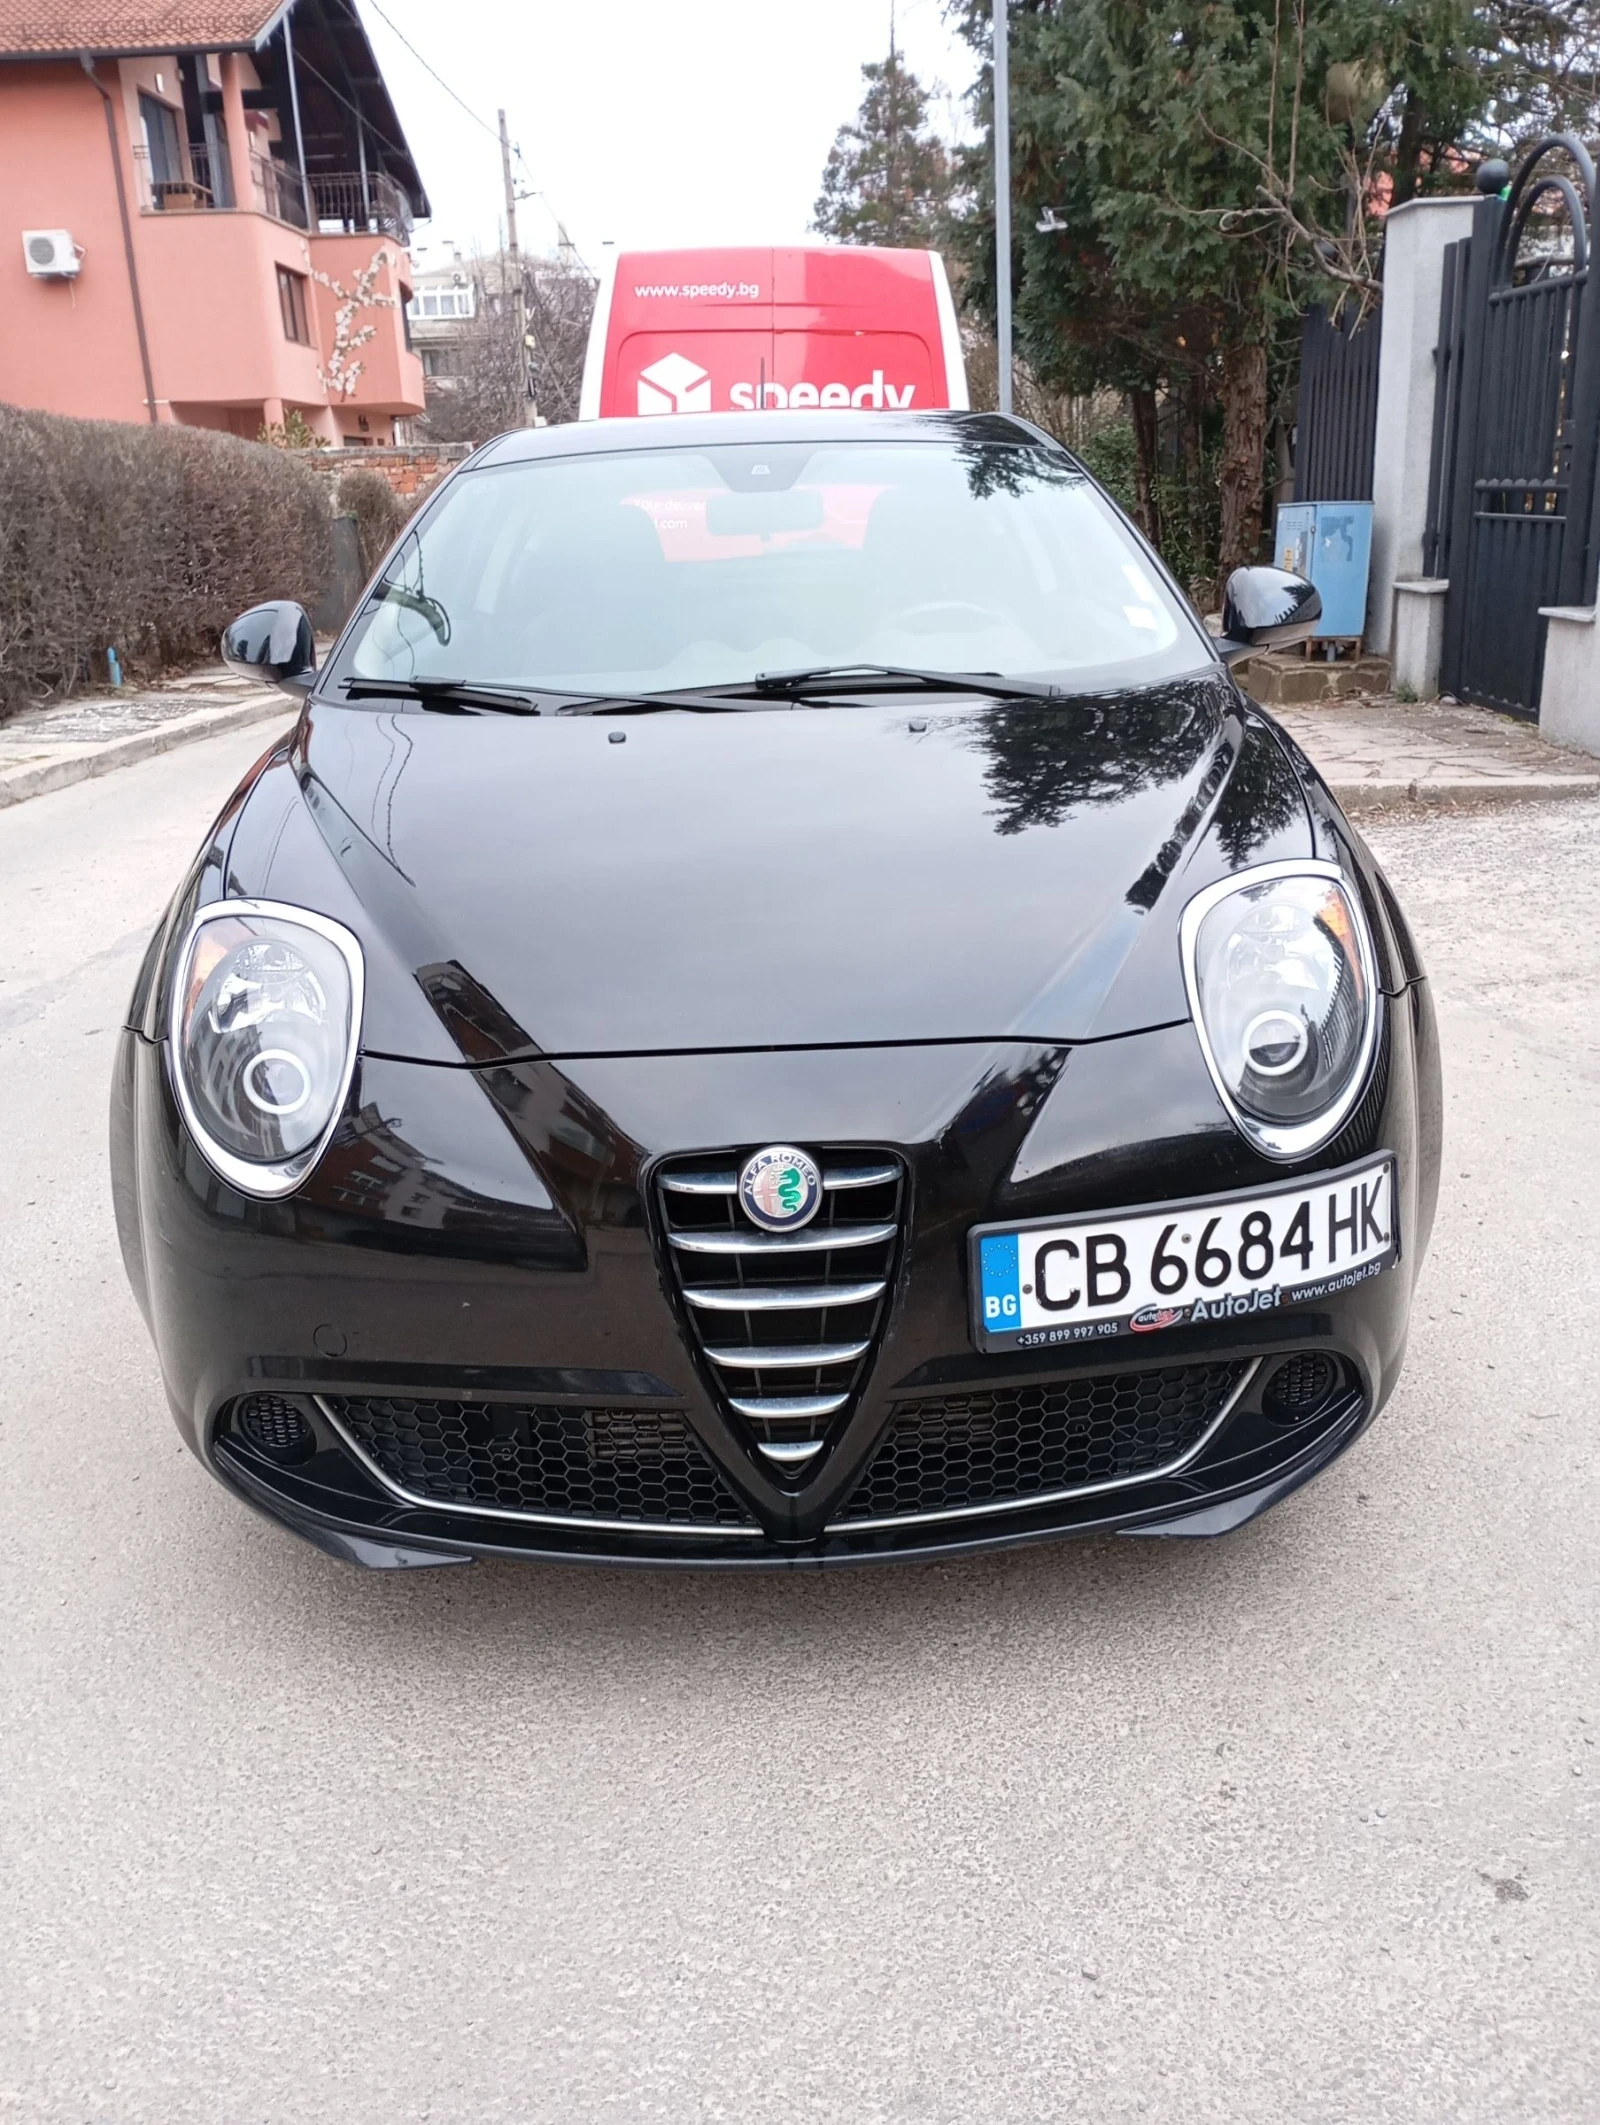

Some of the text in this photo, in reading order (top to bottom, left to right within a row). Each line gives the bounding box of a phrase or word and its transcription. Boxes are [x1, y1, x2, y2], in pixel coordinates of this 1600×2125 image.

[634, 281, 760, 299] www.speedy.bg
[744, 1153, 816, 1195] ALFA ROMEO
[1034, 1174, 1385, 1312] CB 6684 HK
[1291, 1261, 1381, 1302] www.autojet.bg
[985, 1293, 1017, 1318] BG
[1190, 1285, 1283, 1322] AutoJet
[1017, 1322, 1118, 1346] +359 899 997 905
